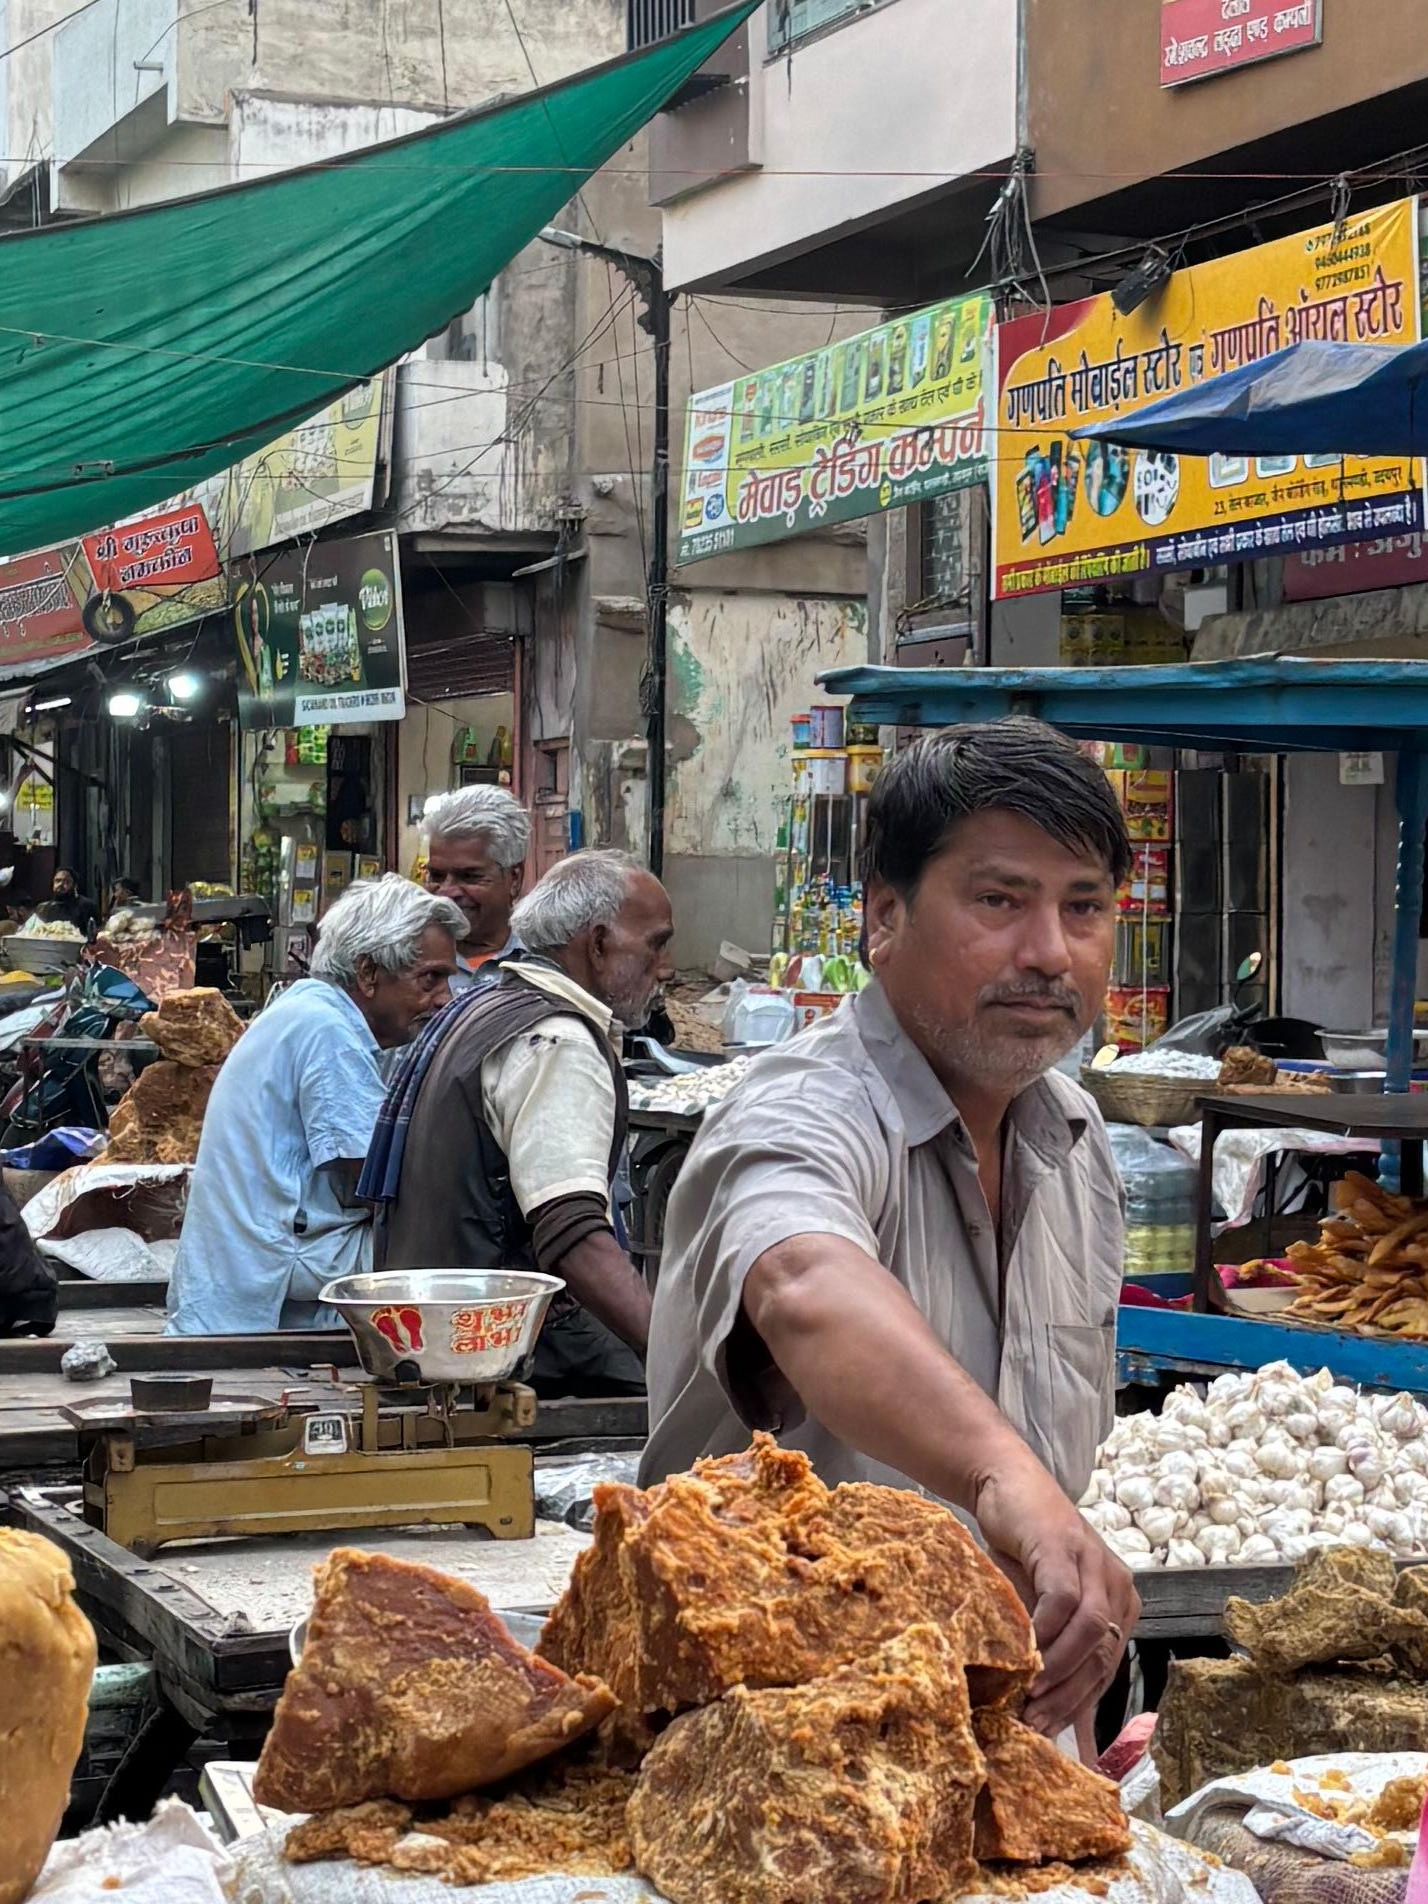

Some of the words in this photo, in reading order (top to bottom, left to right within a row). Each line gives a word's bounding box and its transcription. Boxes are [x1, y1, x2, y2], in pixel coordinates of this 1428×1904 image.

[1008, 357, 1067, 427] गणपति
[1139, 327, 1183, 395] स्टोर
[1210, 296, 1280, 372] गणपति
[1349, 265, 1403, 340] स्टोर
[737, 466, 803, 528] मेवाड़
